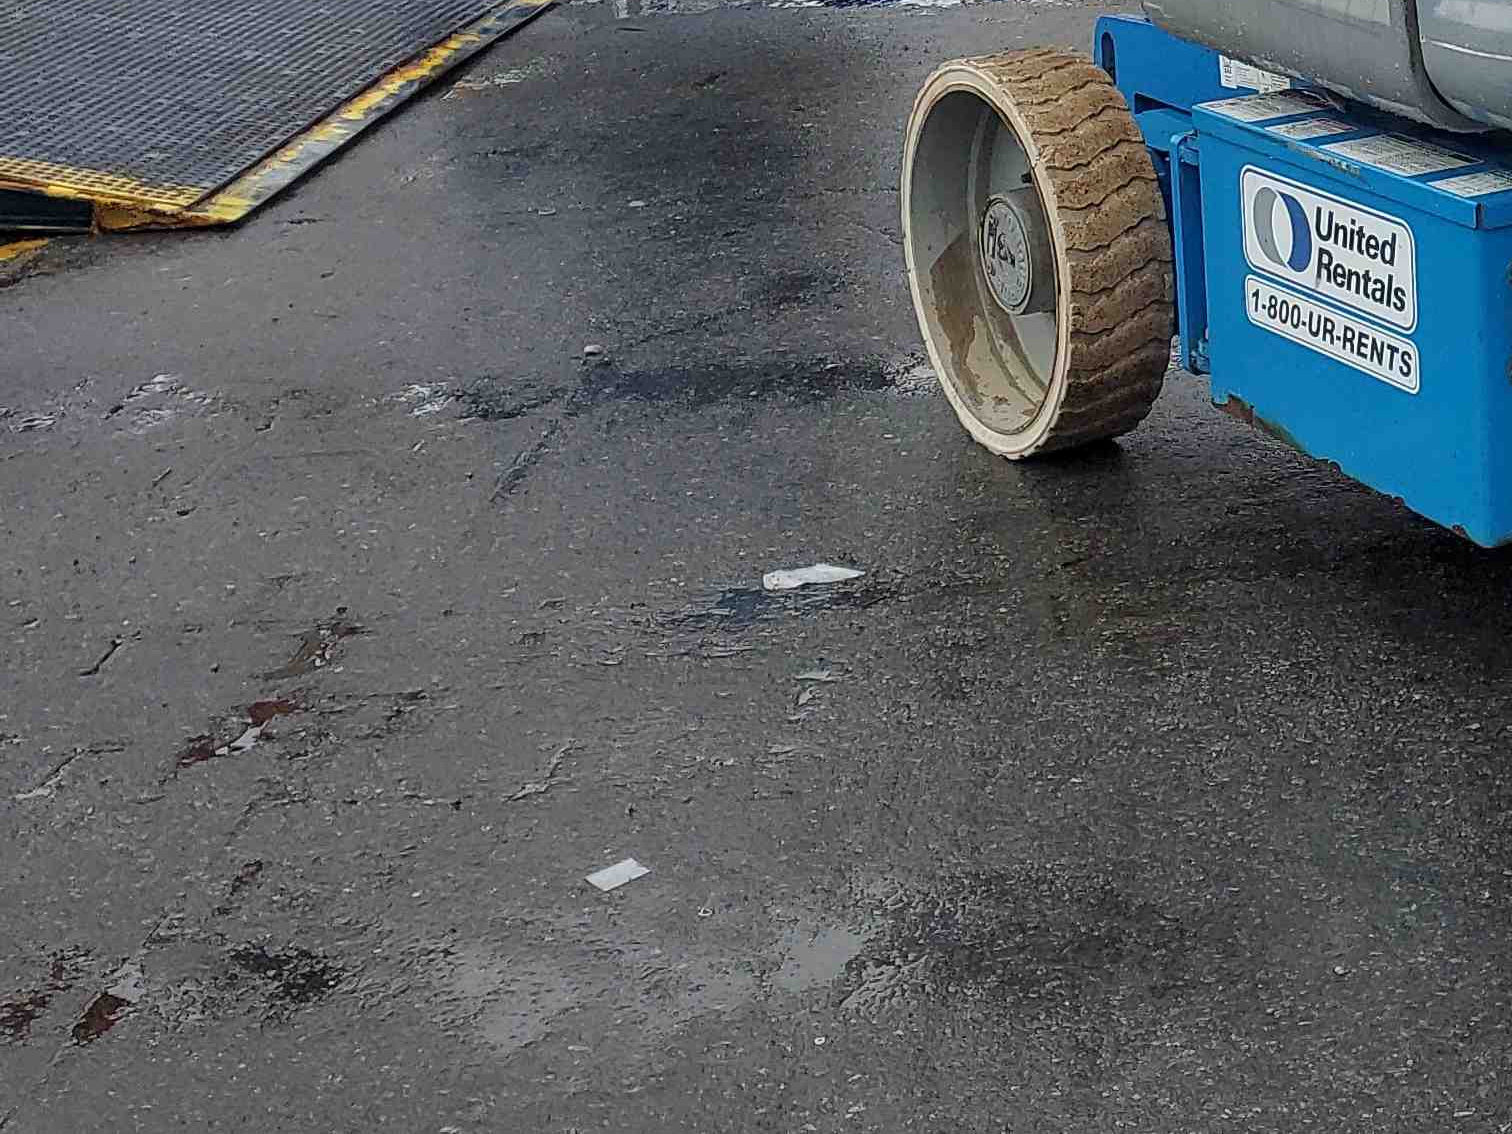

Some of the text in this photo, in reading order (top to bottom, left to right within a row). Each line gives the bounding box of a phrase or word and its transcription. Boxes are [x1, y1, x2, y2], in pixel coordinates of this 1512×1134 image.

[1313, 206, 1397, 267] United
[1316, 246, 1407, 313] Rentals
[1250, 288, 1413, 379] 1-800-UR-RENTS
